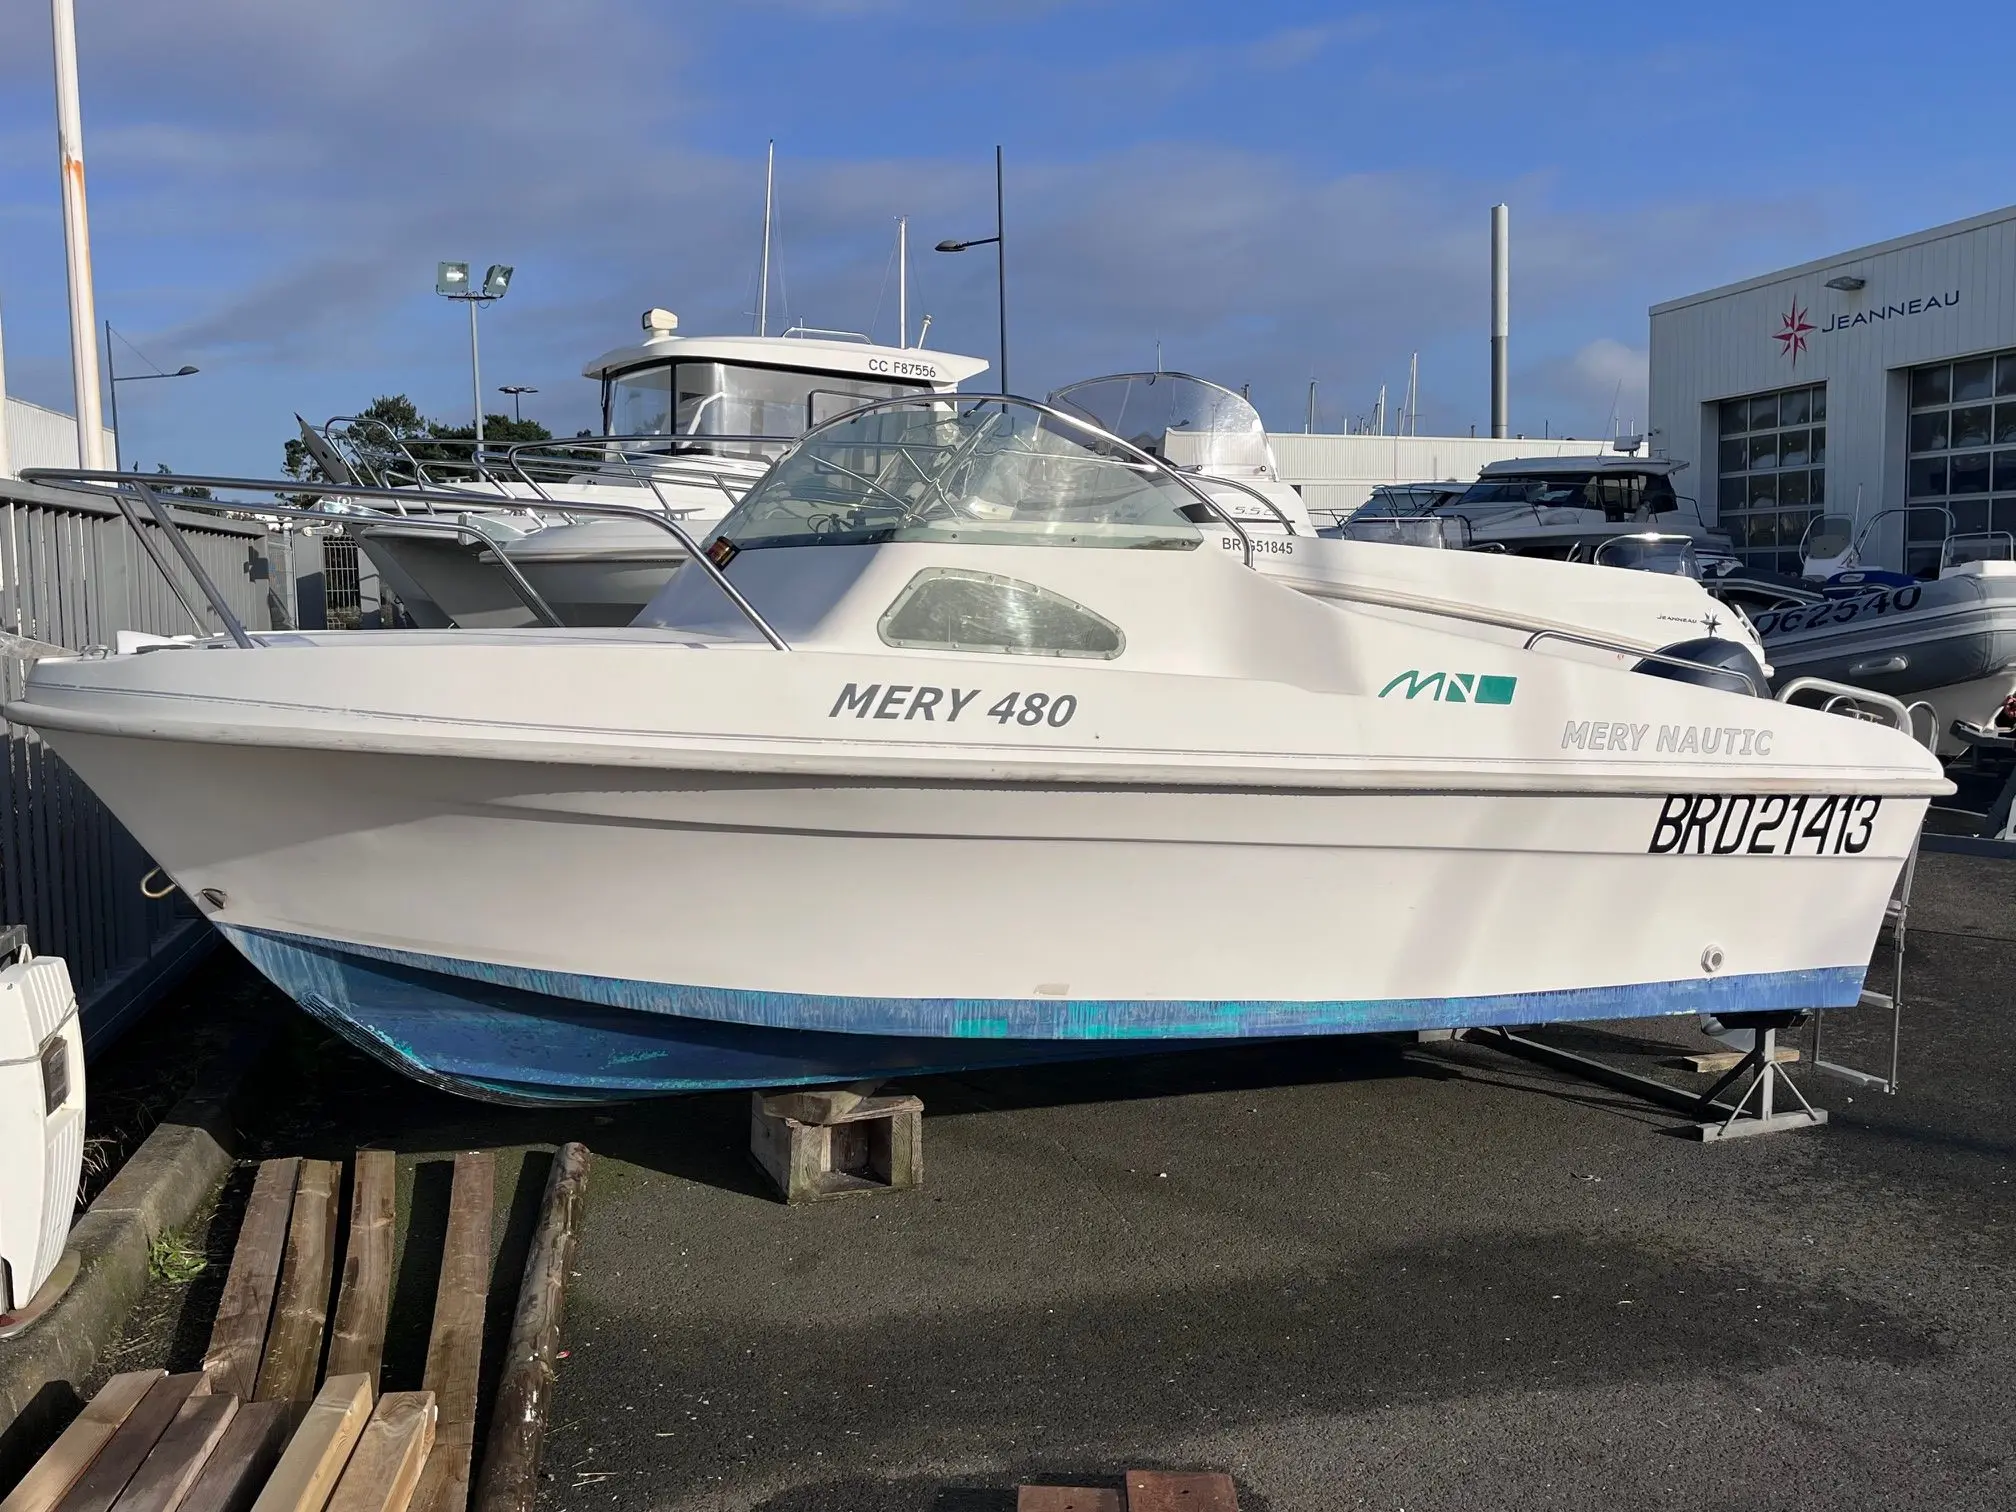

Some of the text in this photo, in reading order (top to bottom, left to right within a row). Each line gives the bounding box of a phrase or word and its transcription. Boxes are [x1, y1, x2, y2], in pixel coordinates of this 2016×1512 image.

[1822, 290, 1960, 333] JEANNEAU
[868, 359, 936, 378] CC F87556
[828, 683, 1078, 728] MERY 480
[1561, 720, 1774, 755] MERY NAUTIC
[1648, 793, 1882, 855] BRD21413
